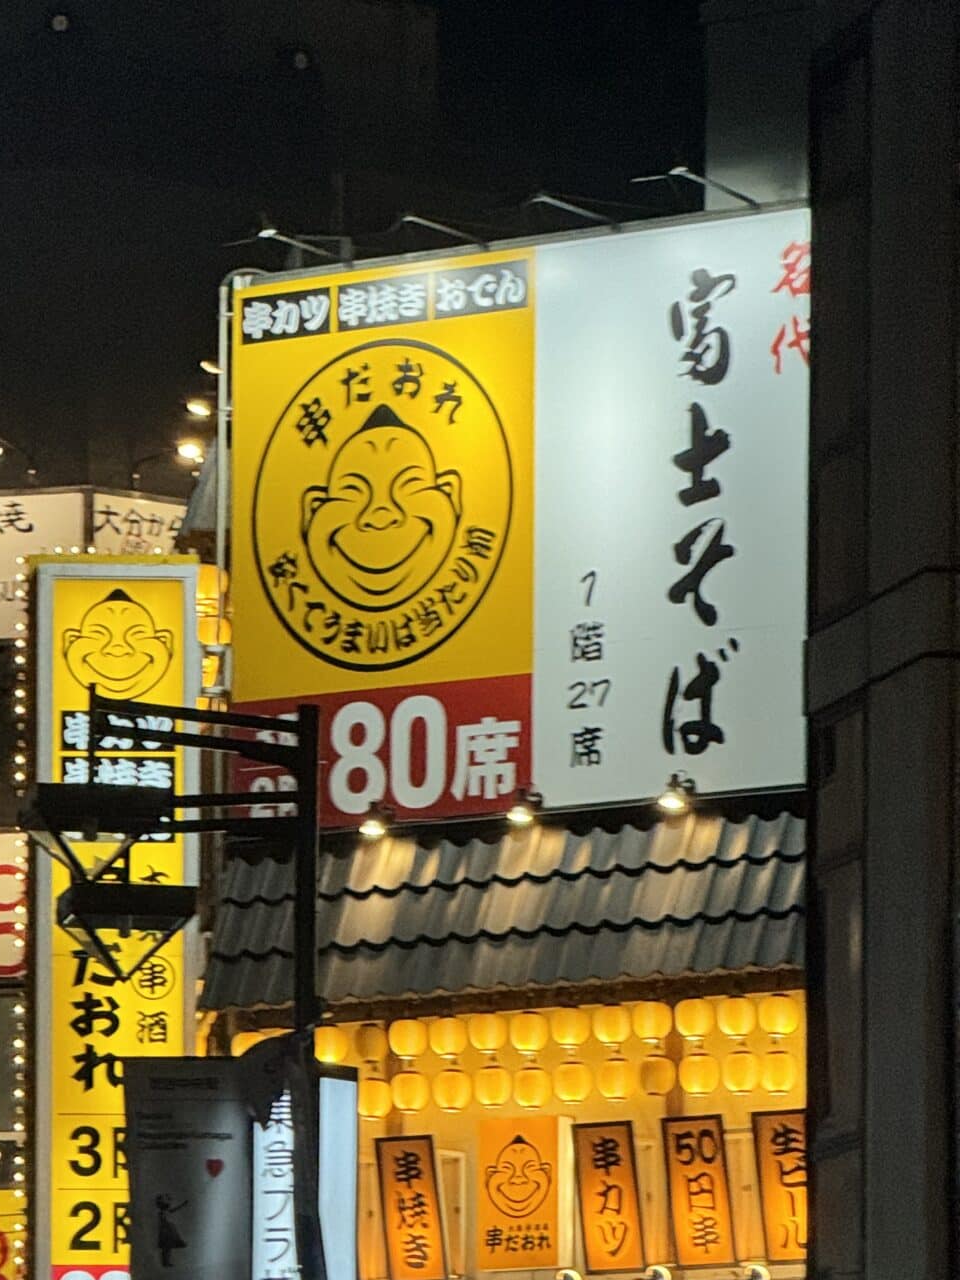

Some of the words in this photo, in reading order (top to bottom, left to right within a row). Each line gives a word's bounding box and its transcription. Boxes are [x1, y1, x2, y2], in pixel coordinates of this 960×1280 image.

[242, 294, 331, 339] 串カツ
[338, 282, 427, 327] 串焼き
[436, 269, 527, 312] おでん
[662, 267, 739, 755] 富士そば
[329, 695, 522, 815] 80席
[592, 1135, 628, 1257] 串カツ
